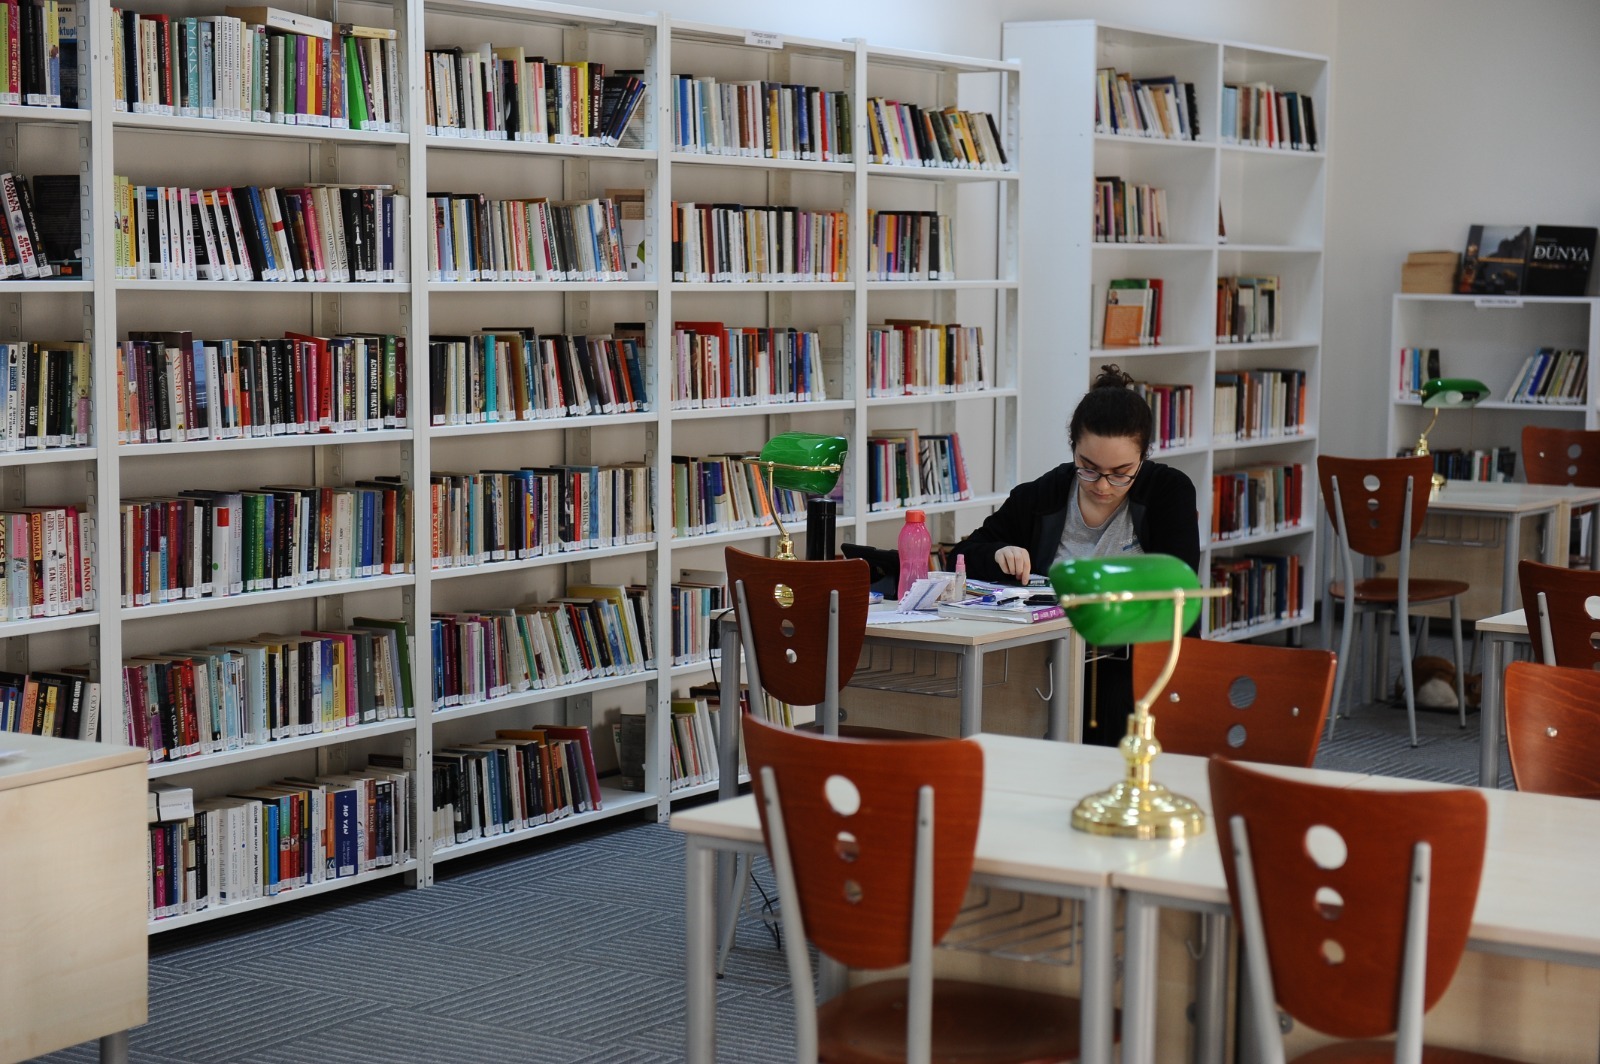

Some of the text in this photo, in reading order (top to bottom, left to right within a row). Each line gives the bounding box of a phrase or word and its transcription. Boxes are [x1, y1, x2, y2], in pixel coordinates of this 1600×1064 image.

[189, 46, 198, 73] KIZ
[4, 178, 16, 213] COBEN
[8, 178, 20, 211] HARLAN
[23, 237, 33, 257] BANA
[1534, 243, 1590, 262] DÜNYA
[83, 557, 91, 592] BANKO
[88, 695, 97, 737] ODYSSEIA
[343, 804, 349, 817] MO
